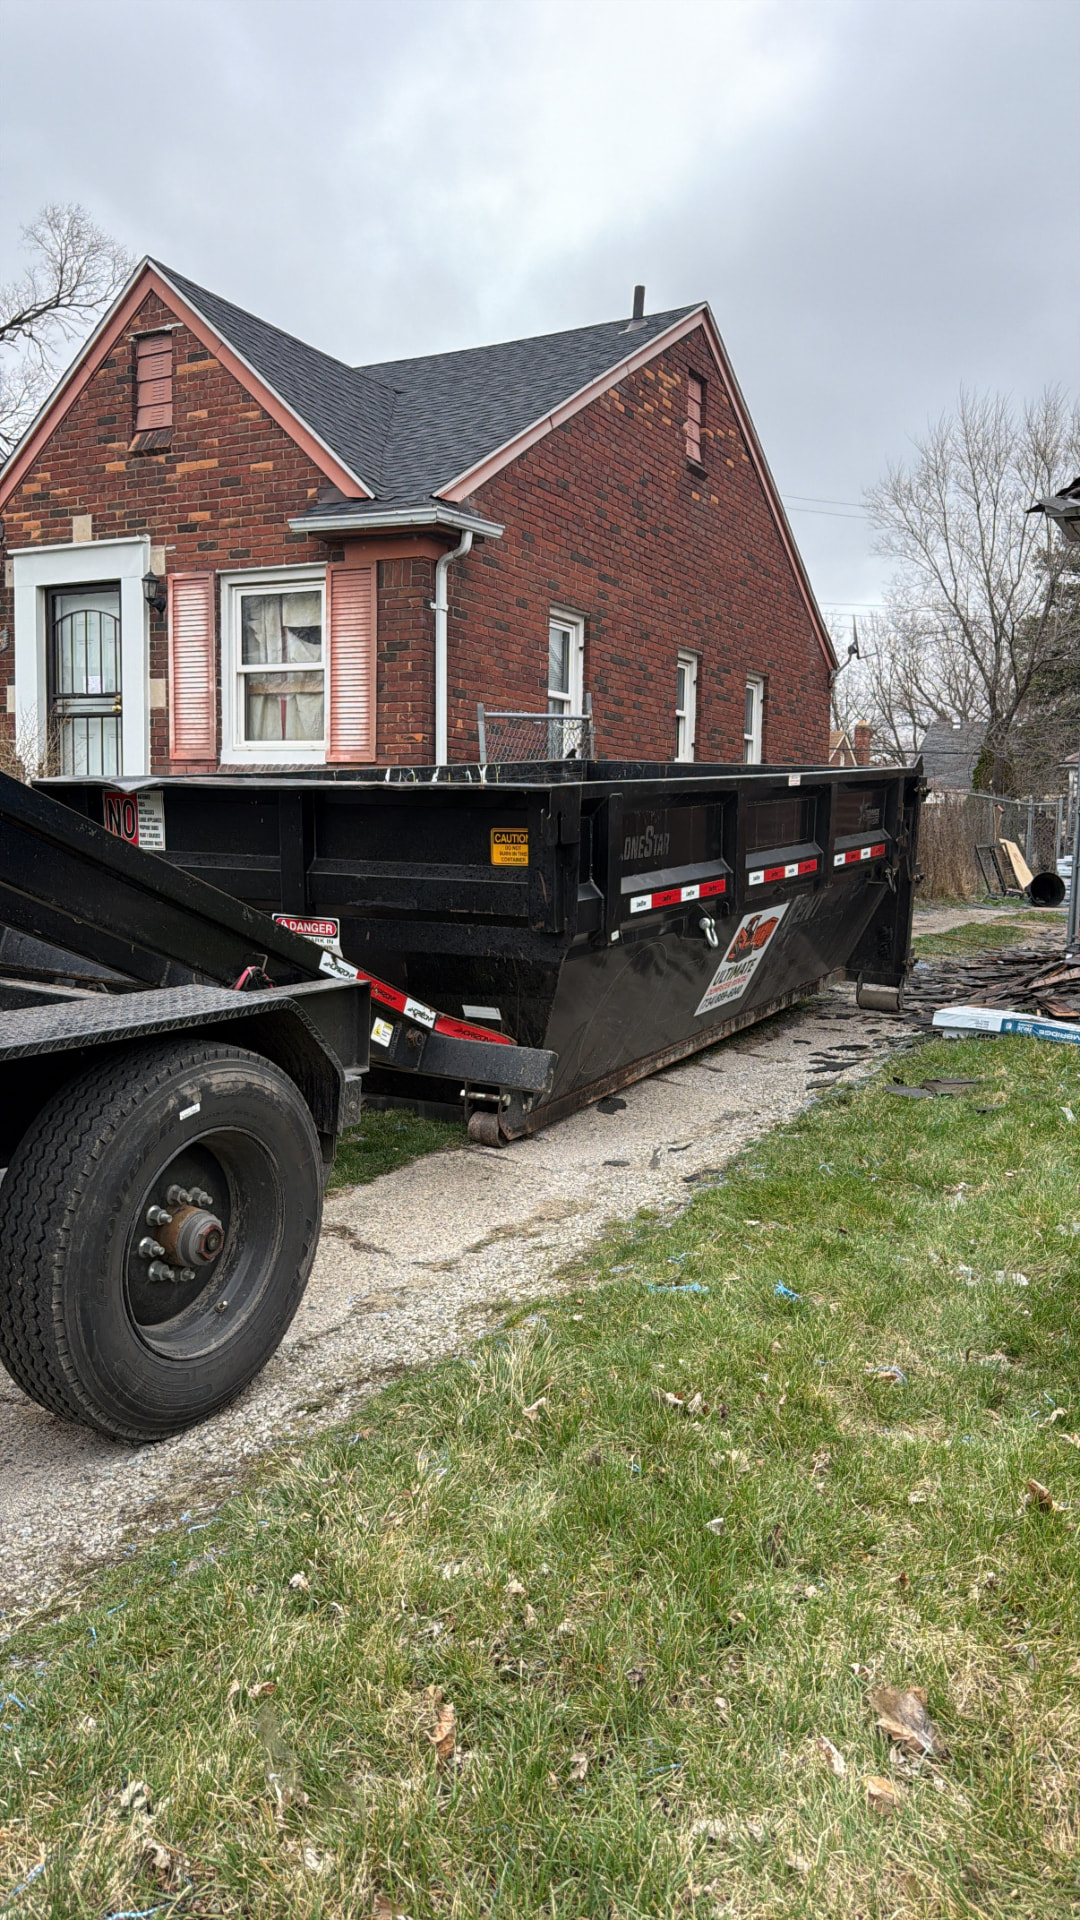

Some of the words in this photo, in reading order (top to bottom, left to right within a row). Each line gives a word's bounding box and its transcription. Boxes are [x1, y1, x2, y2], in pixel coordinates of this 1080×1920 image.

[107, 798, 136, 840] NO
[289, 920, 334, 935] DANGER
[712, 957, 758, 987] ULTIMATE
